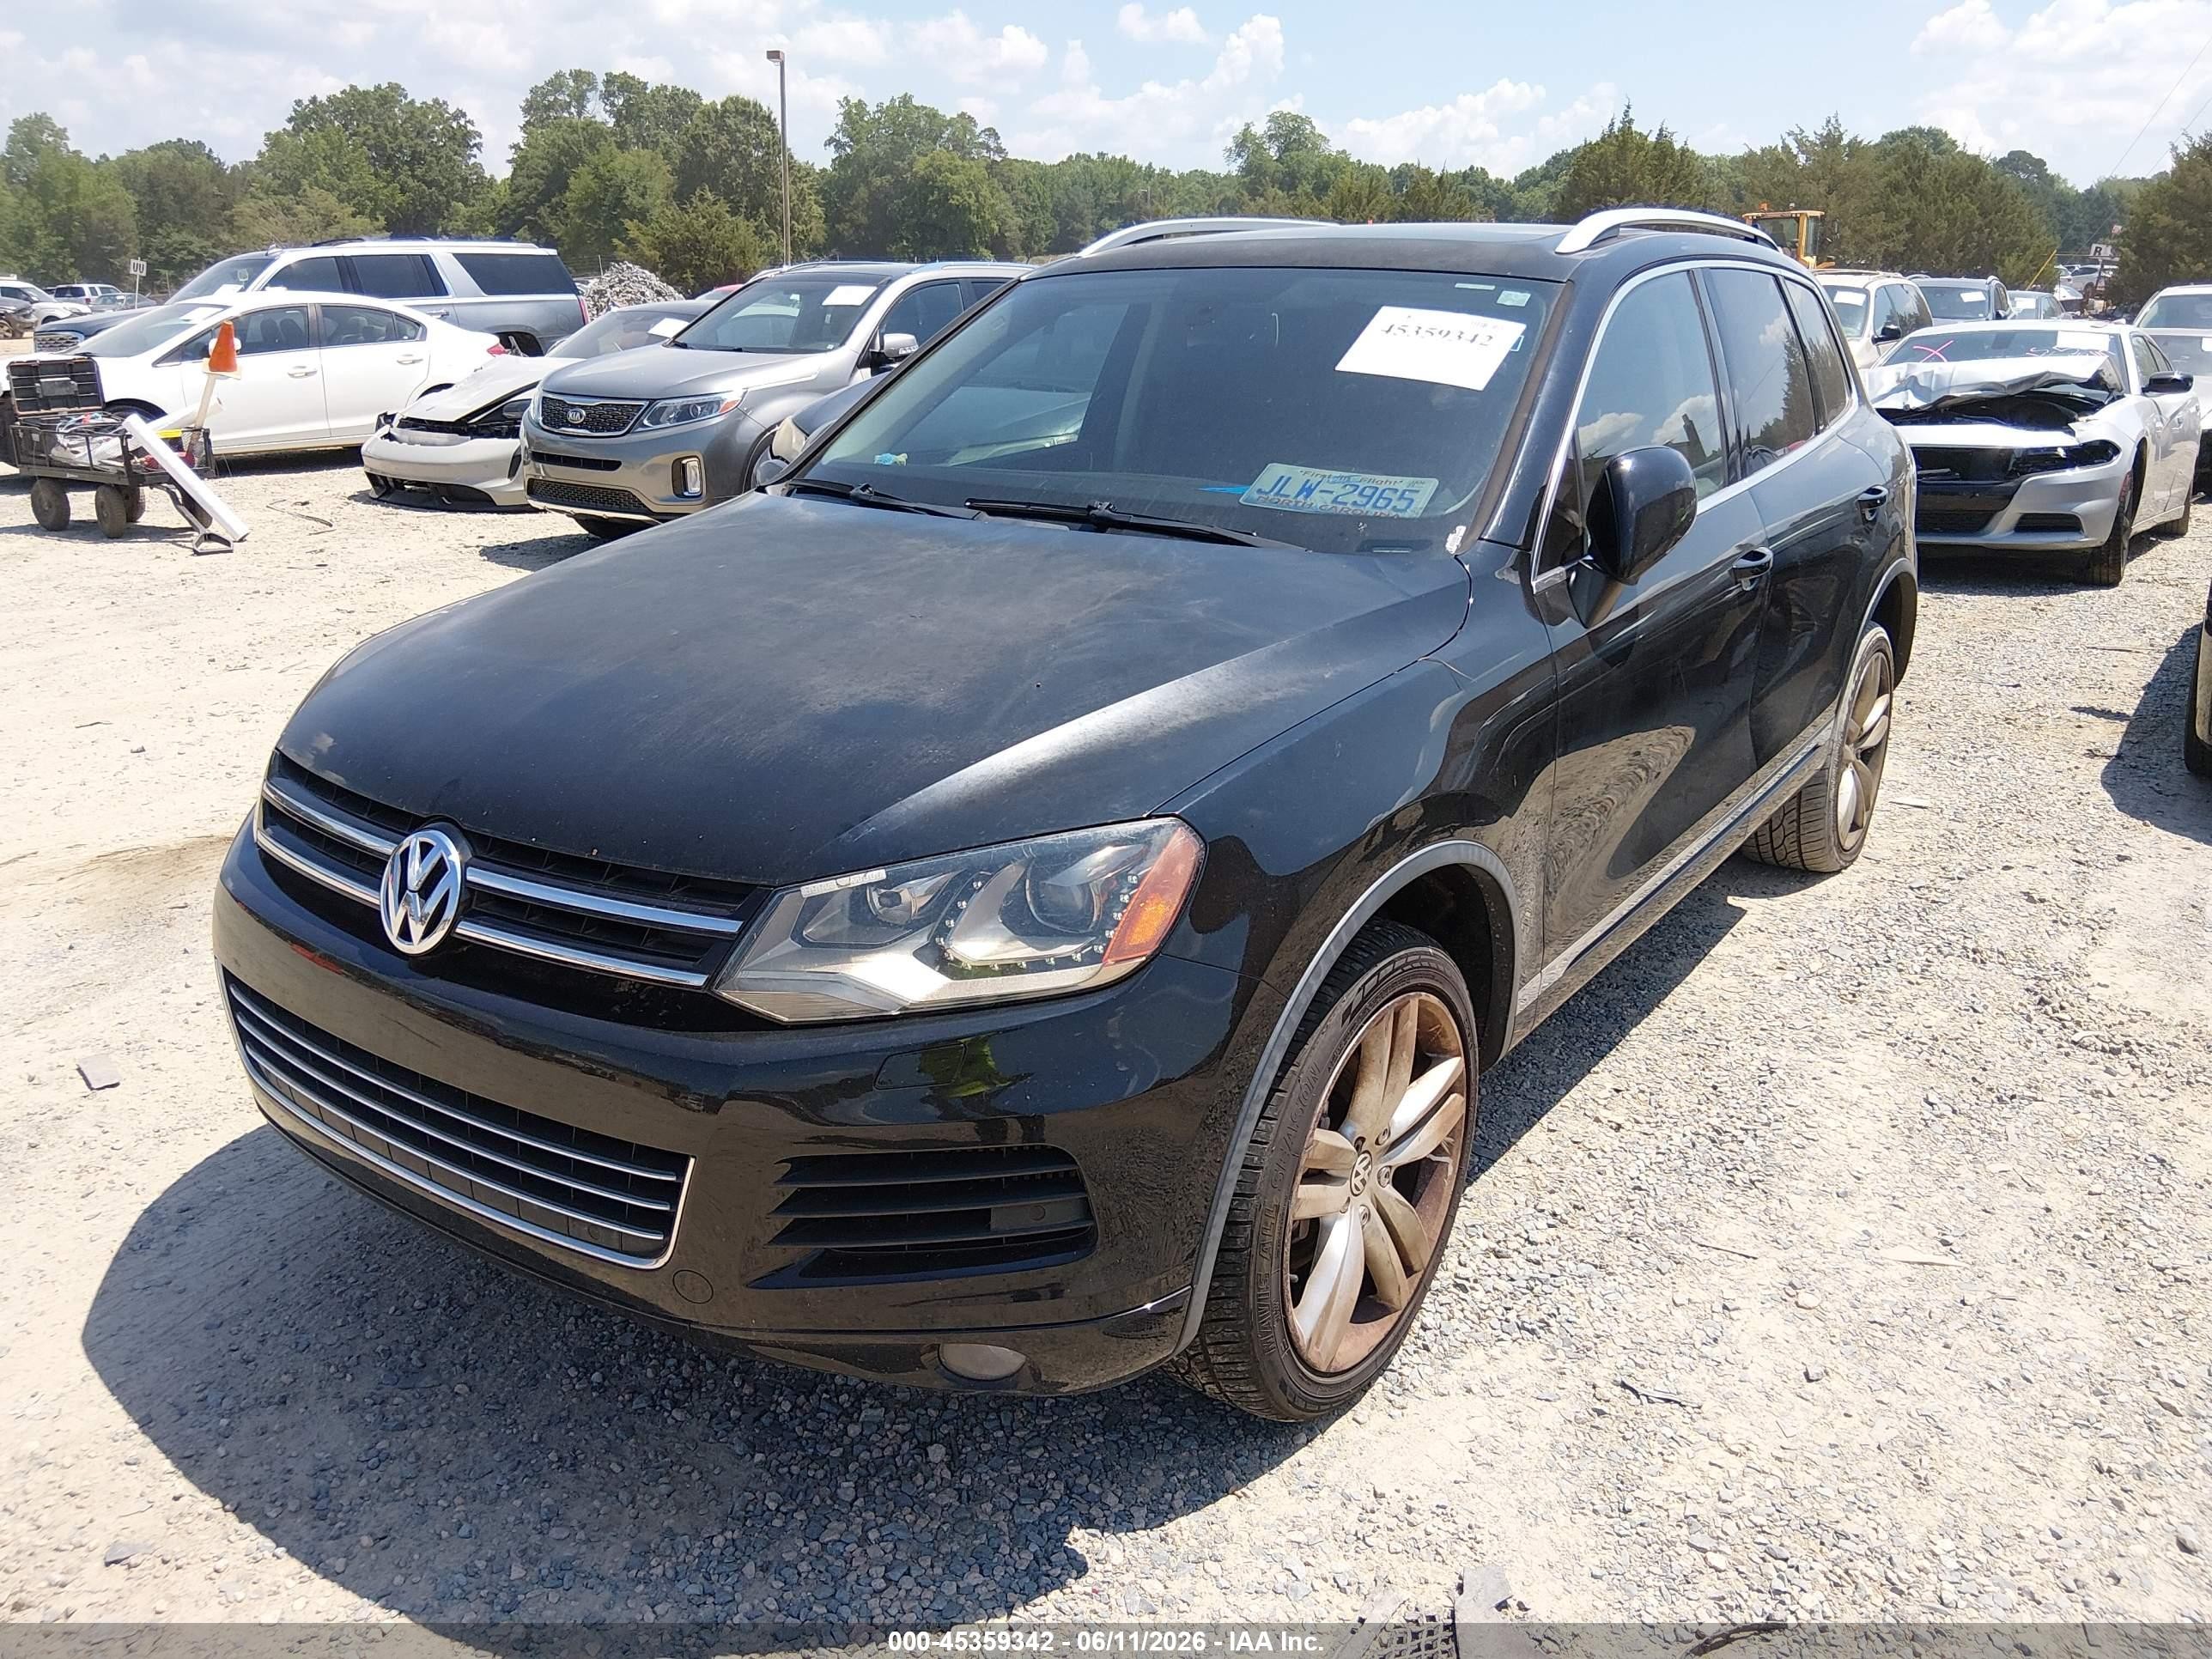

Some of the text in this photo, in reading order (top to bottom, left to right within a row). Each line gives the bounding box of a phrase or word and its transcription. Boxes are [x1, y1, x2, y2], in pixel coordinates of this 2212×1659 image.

[133, 262, 144, 274] UU
[1255, 475, 1420, 513] JLW-2965
[1257, 495, 1314, 509] NORTH
